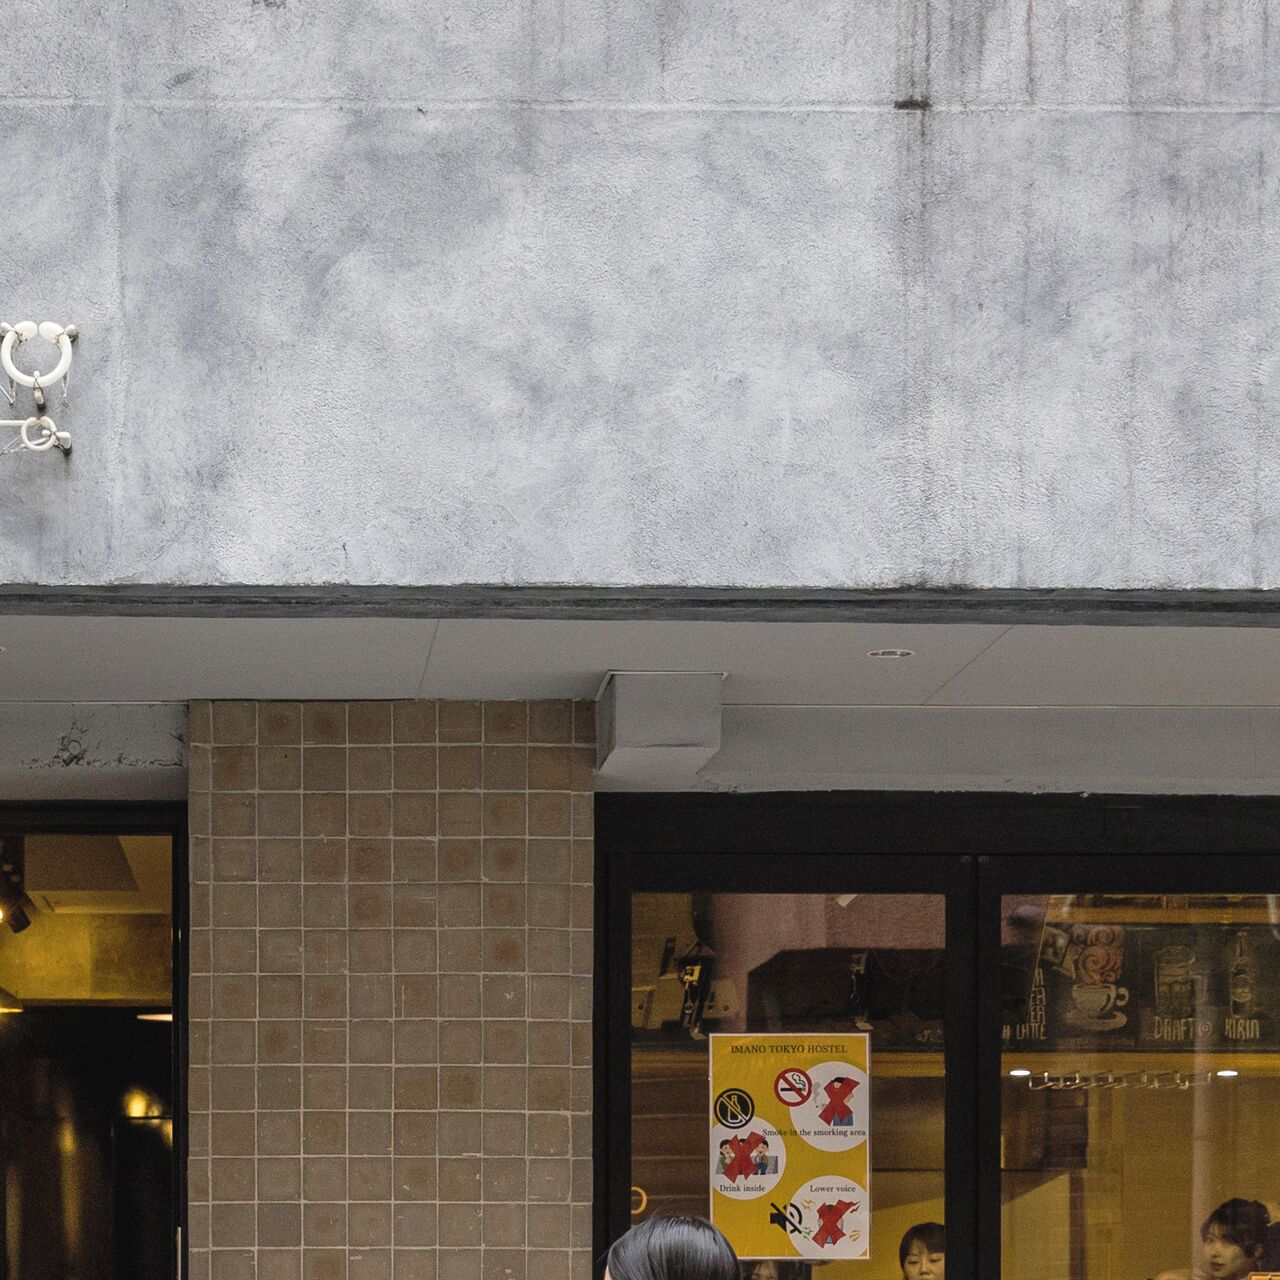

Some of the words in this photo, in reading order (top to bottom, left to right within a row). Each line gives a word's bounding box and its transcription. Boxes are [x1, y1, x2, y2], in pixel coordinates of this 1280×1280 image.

[1225, 1017, 1259, 1039] KIRIN
[731, 1045, 766, 1054] IMANO
[769, 1045, 804, 1054] TOKYO
[807, 1045, 847, 1053] HOSTEL
[762, 1128, 787, 1136] Smoke
[790, 1128, 797, 1136] in
[800, 1128, 811, 1136] the
[720, 1184, 741, 1192] Drink
[743, 1184, 765, 1192] inside
